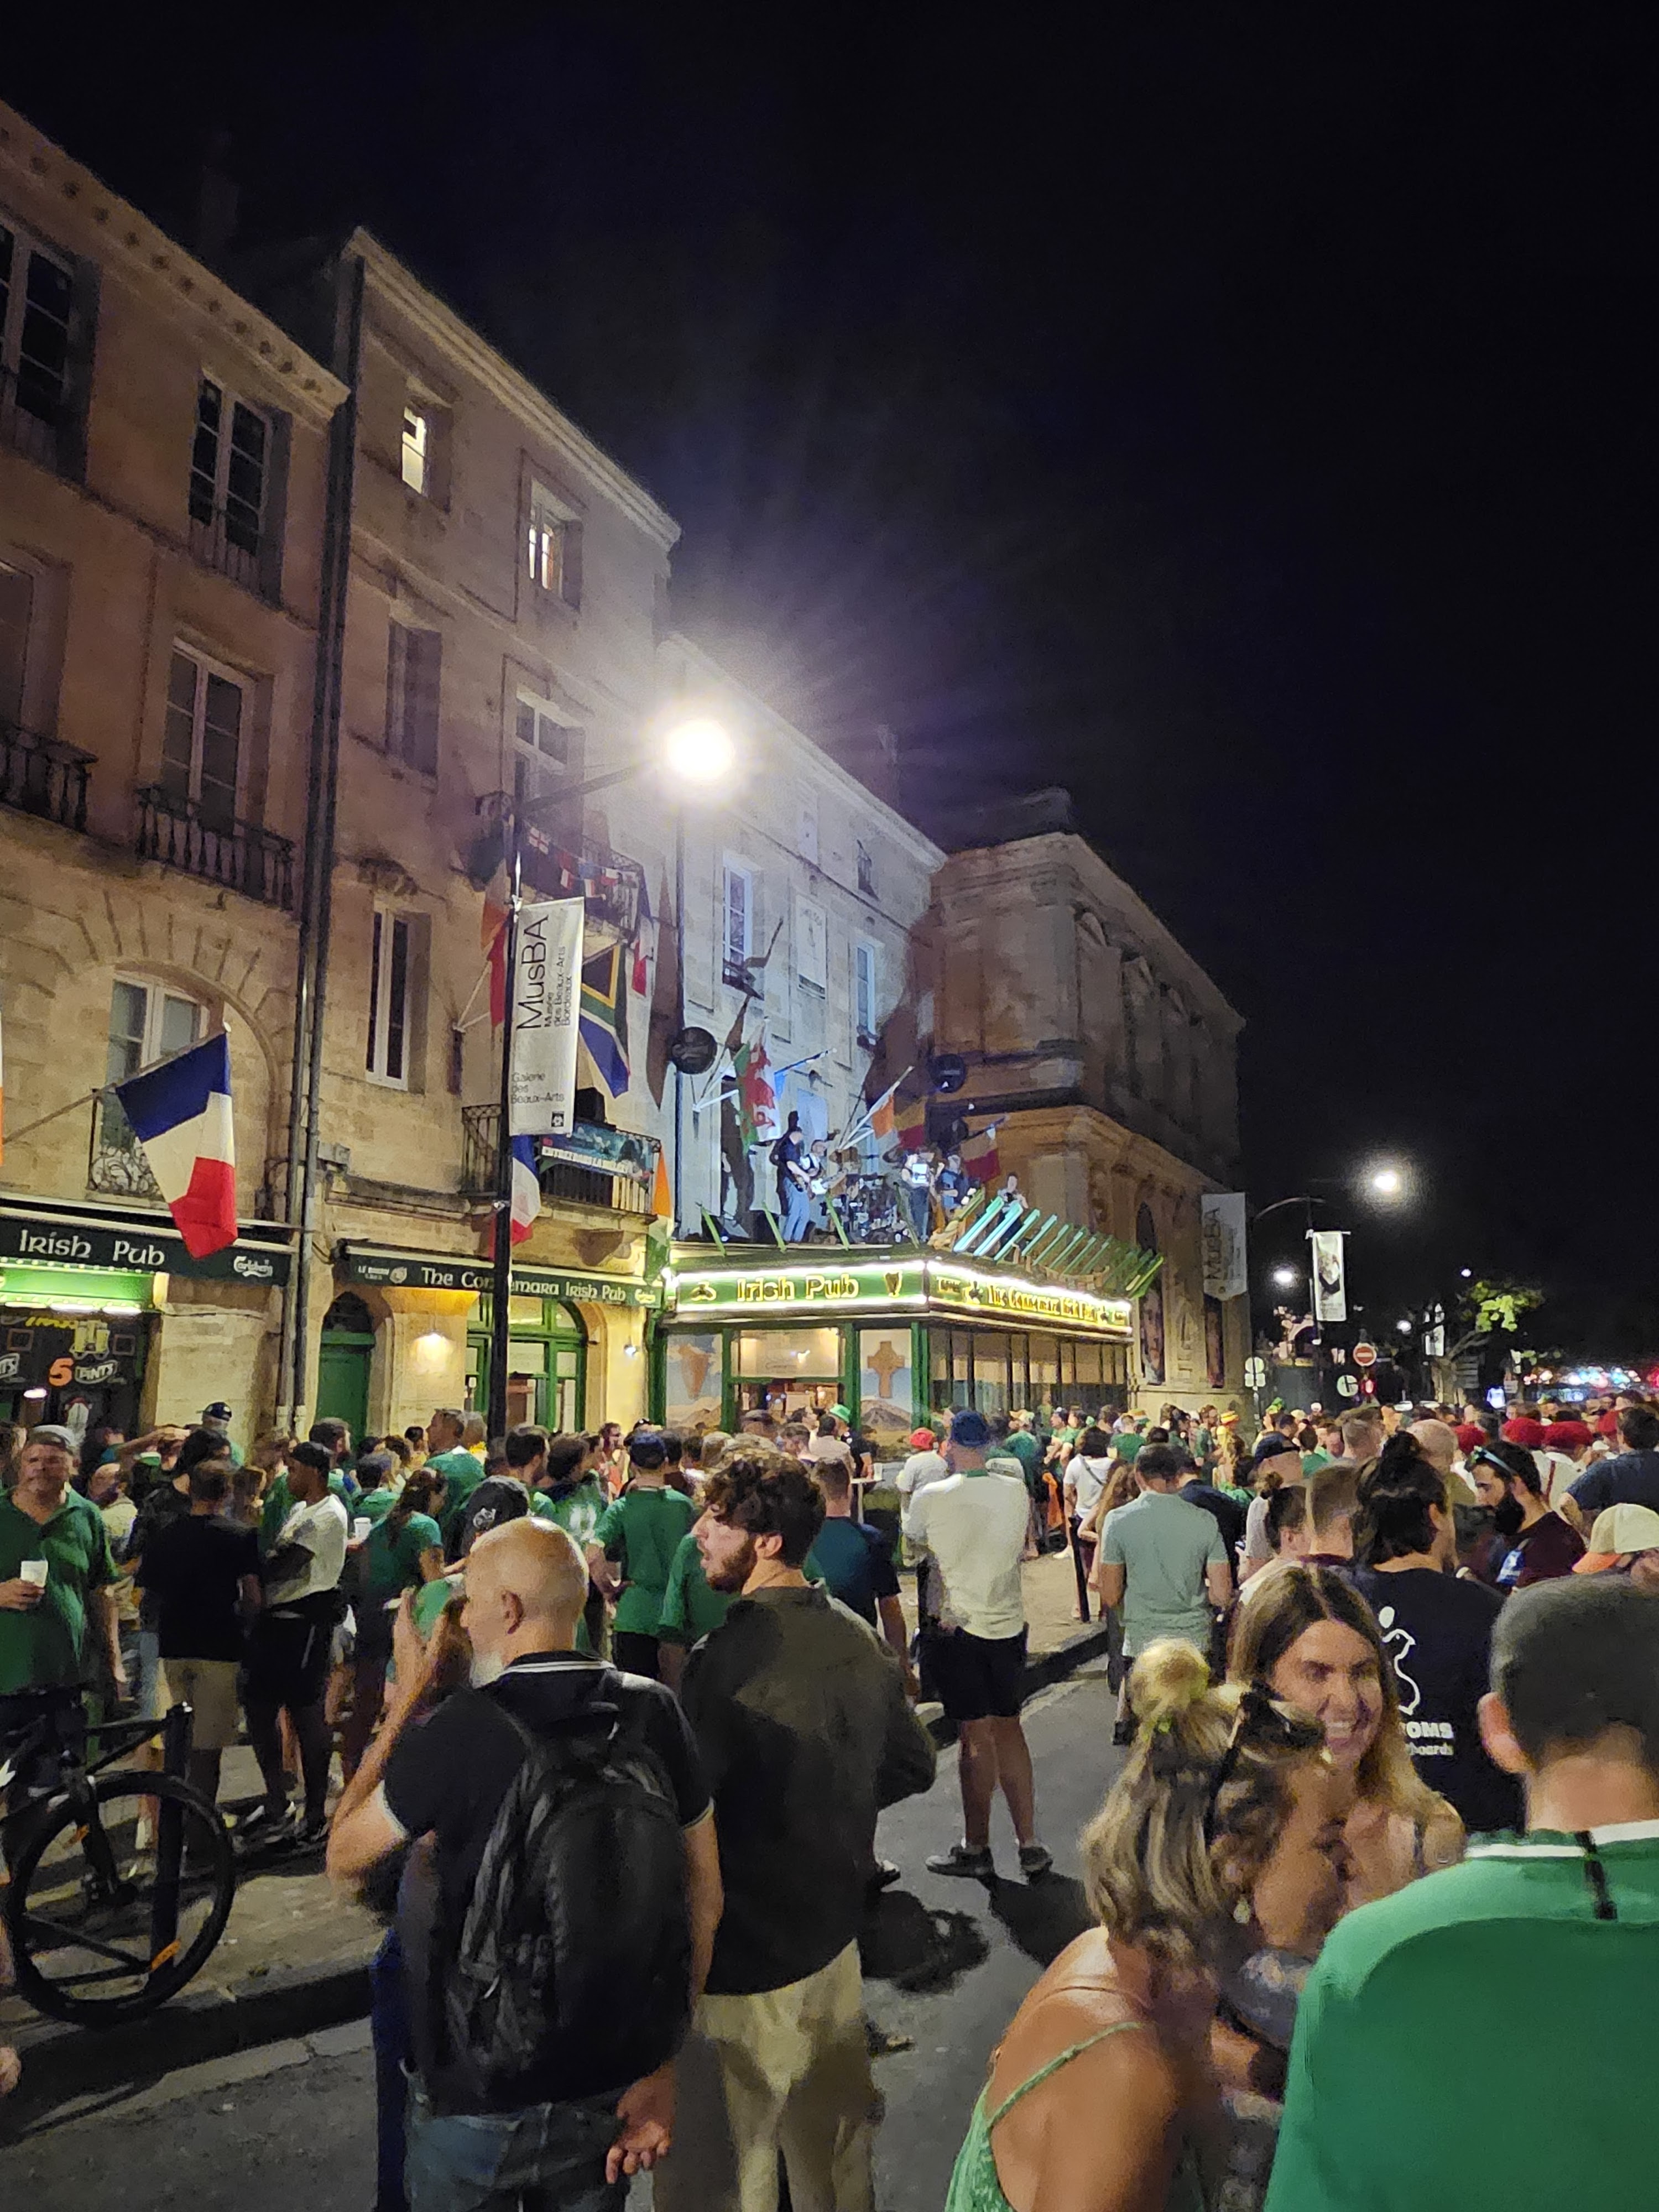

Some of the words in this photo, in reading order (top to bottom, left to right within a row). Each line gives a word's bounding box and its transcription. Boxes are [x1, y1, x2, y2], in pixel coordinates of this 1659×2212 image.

[516, 915, 549, 1031] MusBA
[561, 975, 572, 1026] Bordeaux
[19, 1229, 91, 1258] Irish
[112, 1240, 165, 1266] Pub
[421, 1267, 453, 1286] The
[566, 1281, 598, 1300] Irish
[602, 1284, 626, 1301] Pub
[737, 1277, 795, 1302] Irish
[805, 1274, 859, 1300] Pub
[49, 1358, 74, 1386] 5
